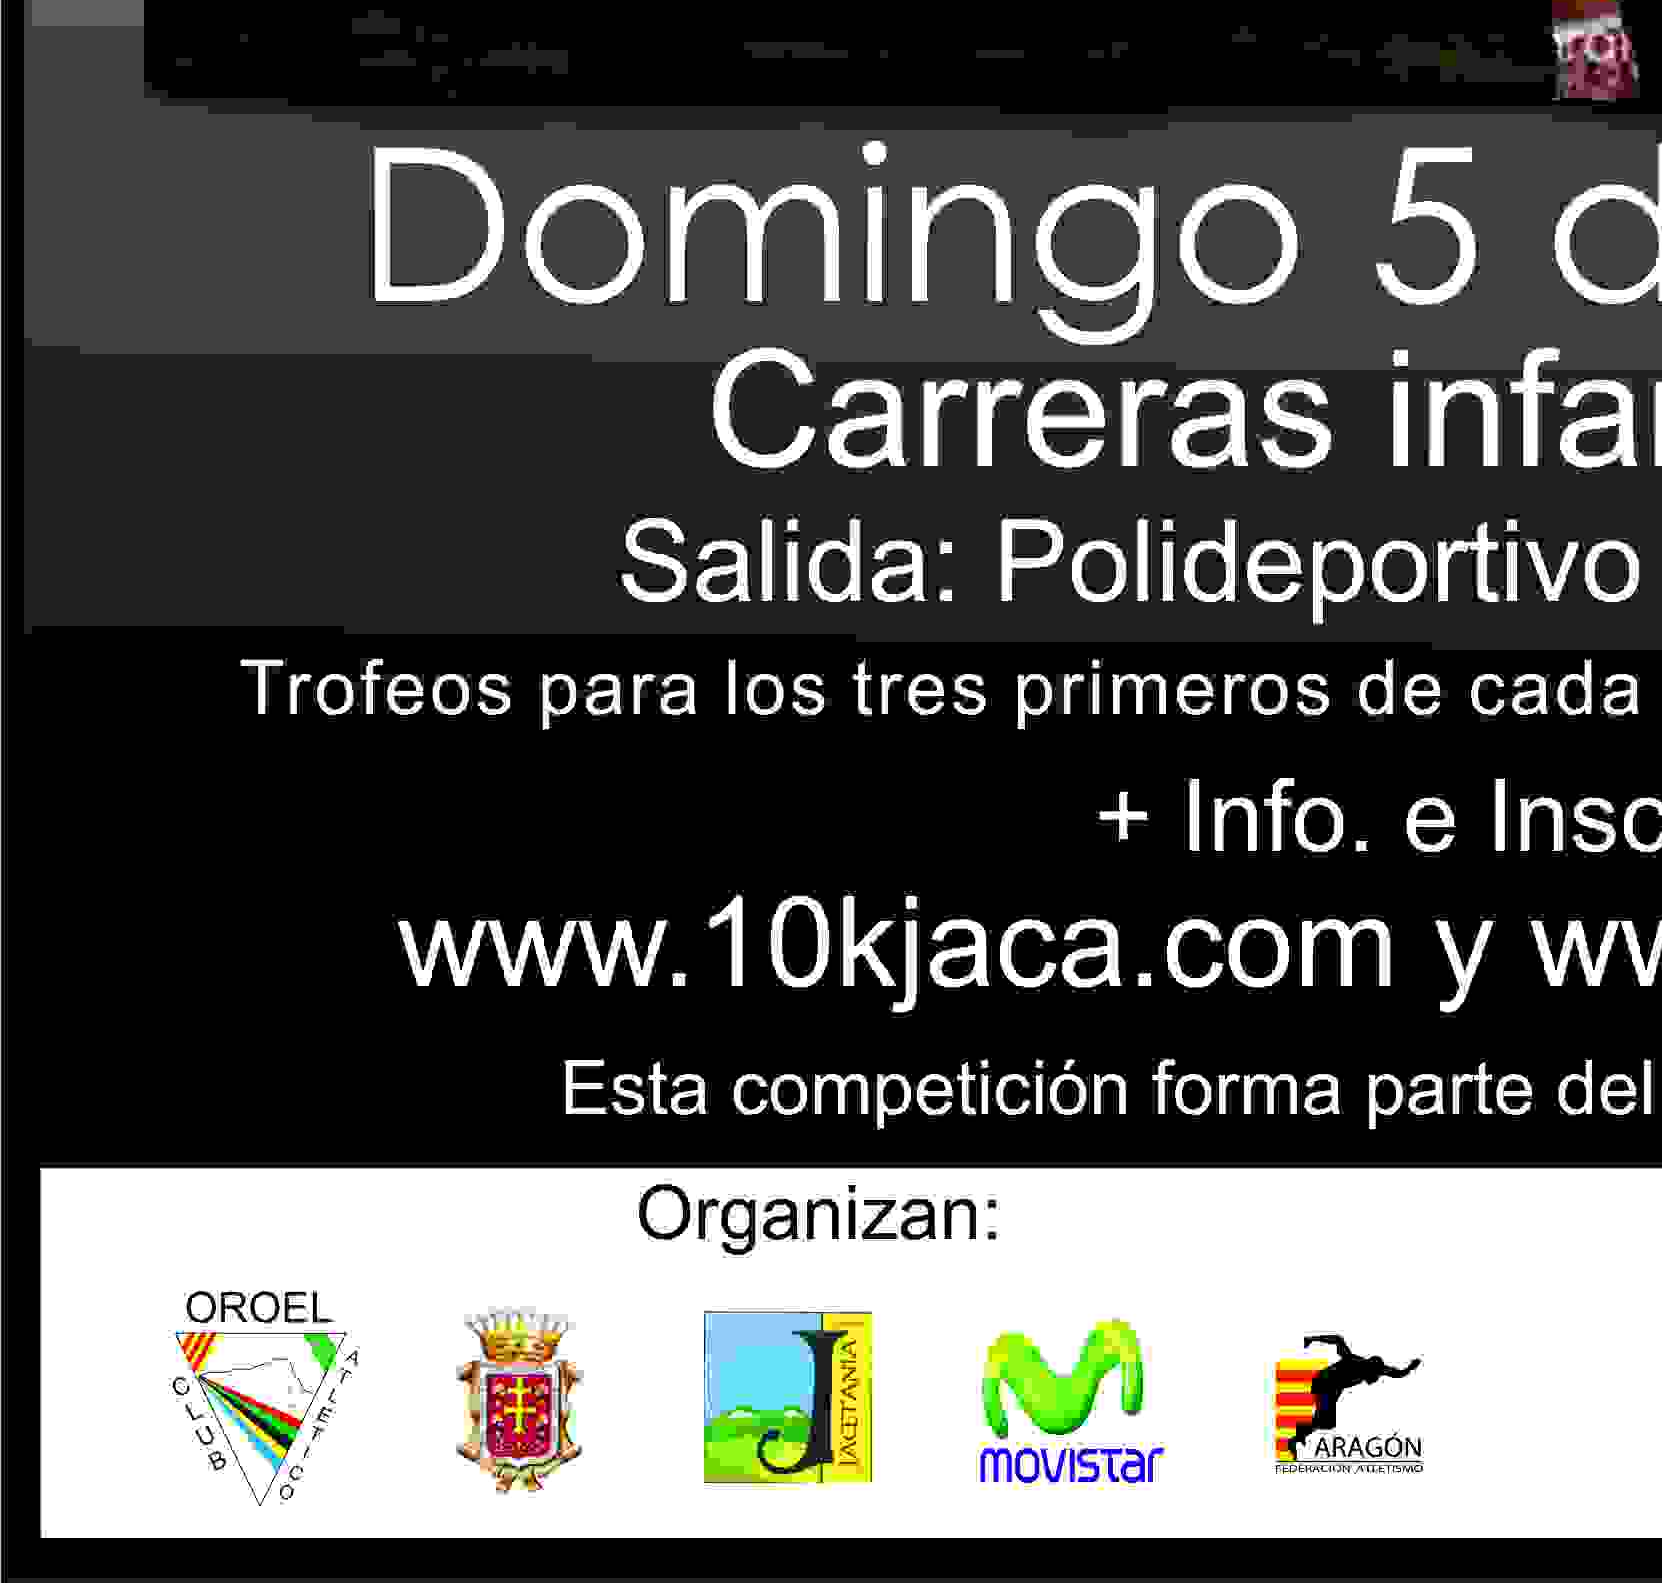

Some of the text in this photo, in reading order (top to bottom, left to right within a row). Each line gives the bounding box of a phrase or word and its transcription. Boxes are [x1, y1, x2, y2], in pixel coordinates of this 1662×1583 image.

[375, 141, 1297, 345] Domingo
[1376, 147, 1475, 306] 5
[712, 348, 1331, 468] Carreras
[622, 518, 952, 602] Salida:
[1002, 519, 1639, 624] Polideportivo
[241, 659, 510, 715] Trofeos
[543, 674, 695, 730] para
[729, 660, 824, 715] los
[853, 663, 985, 715] tres
[1018, 660, 1329, 730] primeros
[1359, 660, 1440, 715] de
[1471, 660, 1638, 715] cada
[1100, 792, 1147, 842] +
[1190, 778, 1368, 851] Info.
[1407, 798, 1456, 852] e
[398, 896, 1390, 1012] www.10kjaca.com
[1436, 920, 1493, 1012] y
[565, 1060, 706, 1115] Esta
[734, 1060, 1126, 1130] competición
[1152, 1059, 1339, 1115] forma
[1369, 1063, 1532, 1129] parte
[1559, 1060, 1651, 1115] del
[639, 1184, 996, 1255] Organizan:
[187, 1291, 332, 1323] OROEL
[172, 1377, 227, 1472] CLUB
[1314, 1431, 1422, 1458] ARAGÓN
[980, 1448, 1164, 1483] movistar
